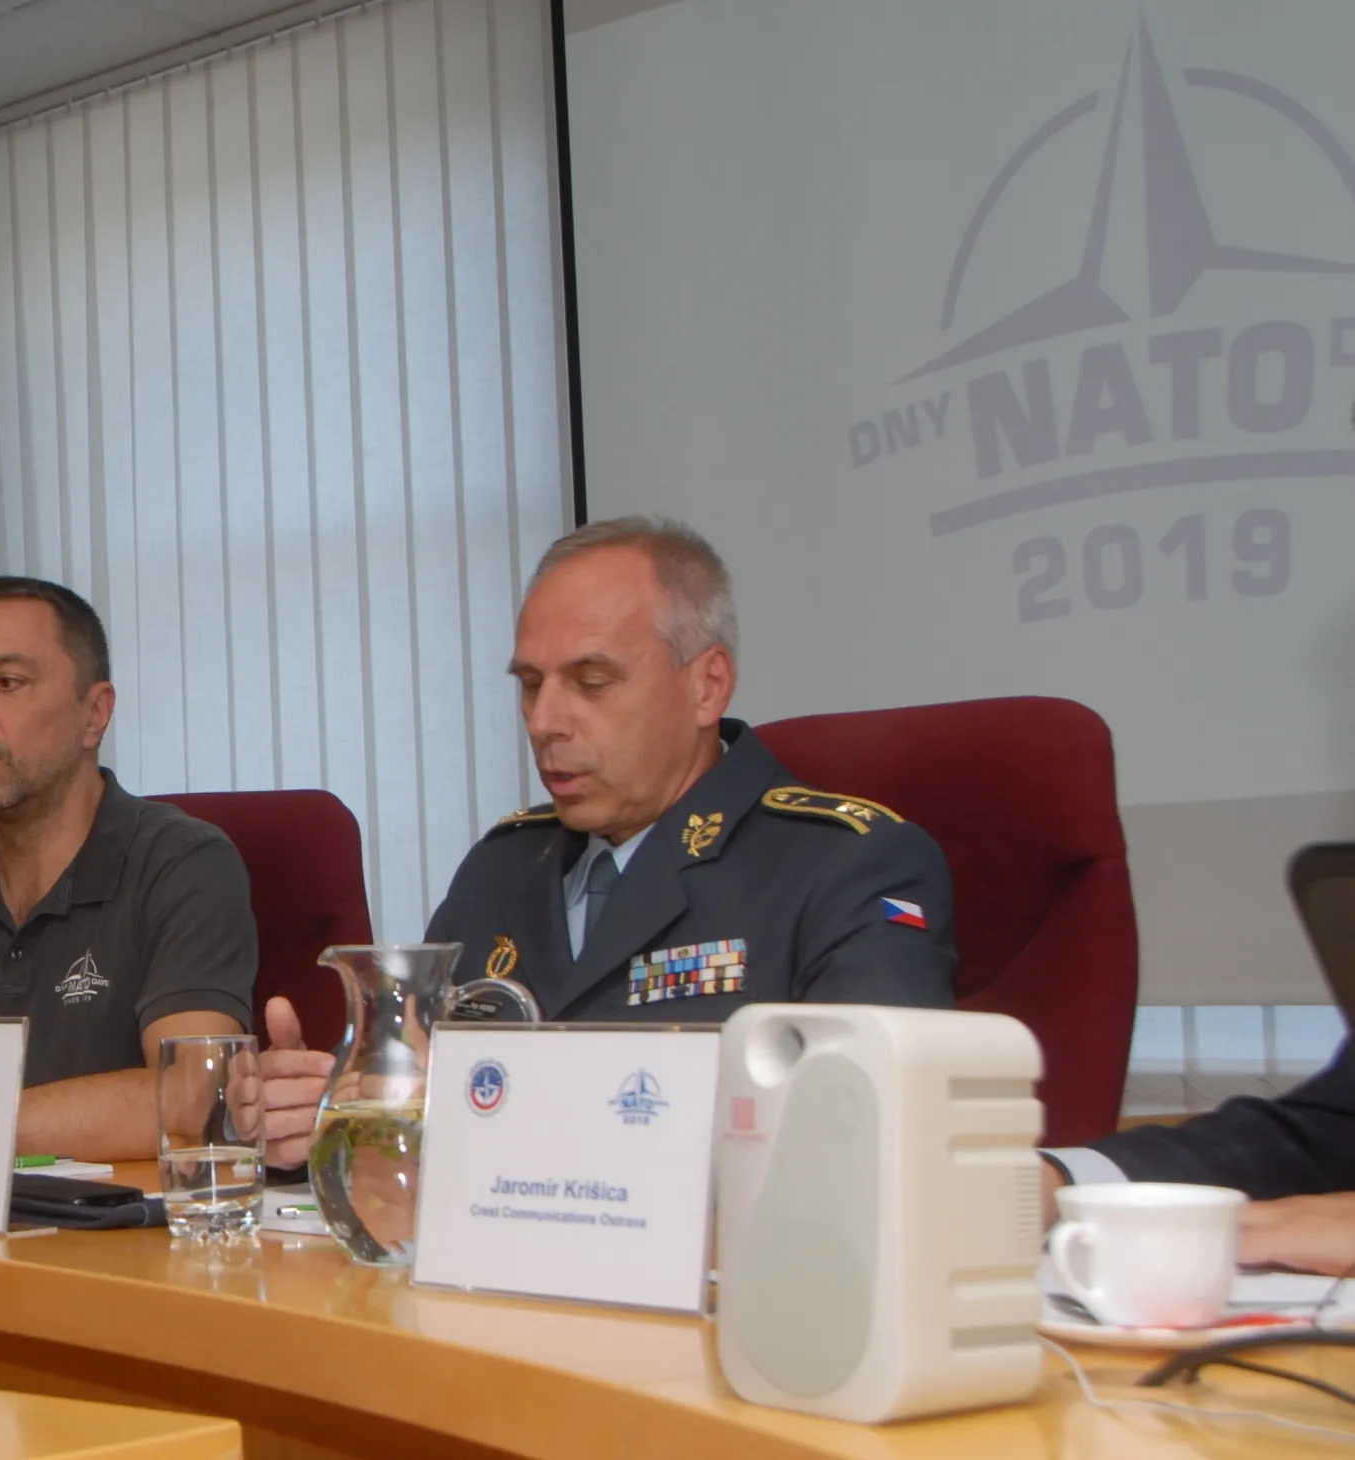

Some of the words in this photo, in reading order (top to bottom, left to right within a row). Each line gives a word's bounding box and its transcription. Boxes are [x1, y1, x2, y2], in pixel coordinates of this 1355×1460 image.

[847, 390, 951, 470] DNY
[966, 319, 1316, 482] NATO
[1011, 507, 1292, 625] 2019
[501, 1206, 597, 1226] Communications
[599, 1213, 647, 1229] Ostrava
